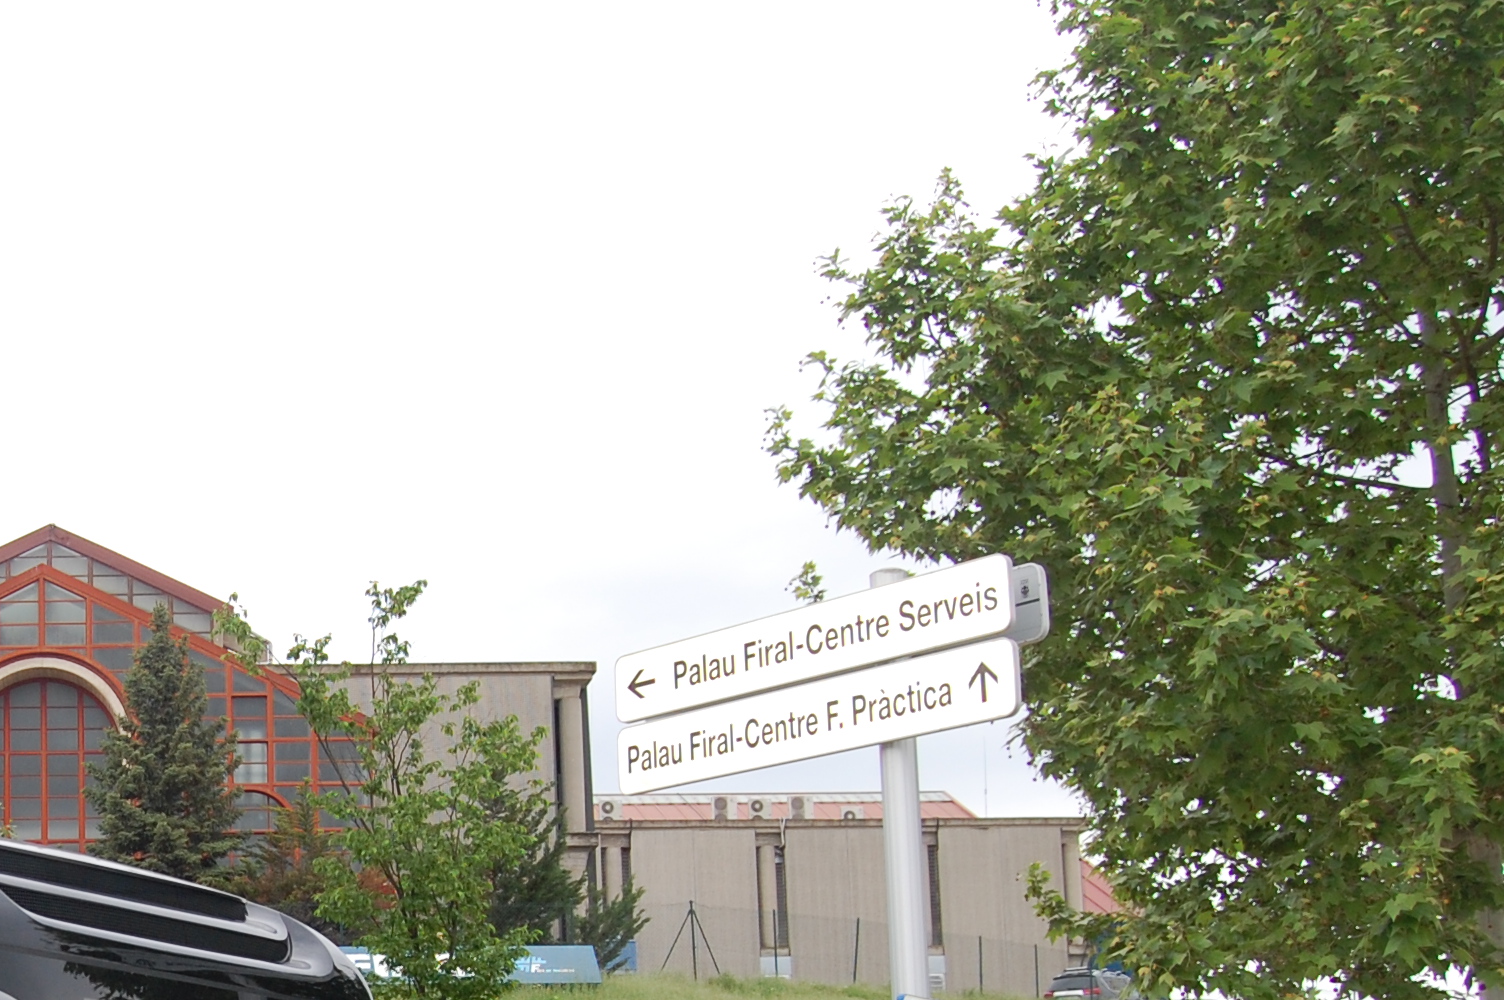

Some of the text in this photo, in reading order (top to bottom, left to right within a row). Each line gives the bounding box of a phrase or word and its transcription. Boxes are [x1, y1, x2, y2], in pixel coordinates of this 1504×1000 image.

[673, 582, 998, 689] Palau Firal-Centre Serveis
[627, 681, 952, 774] Palau Firal-Centre F. Pràctica
